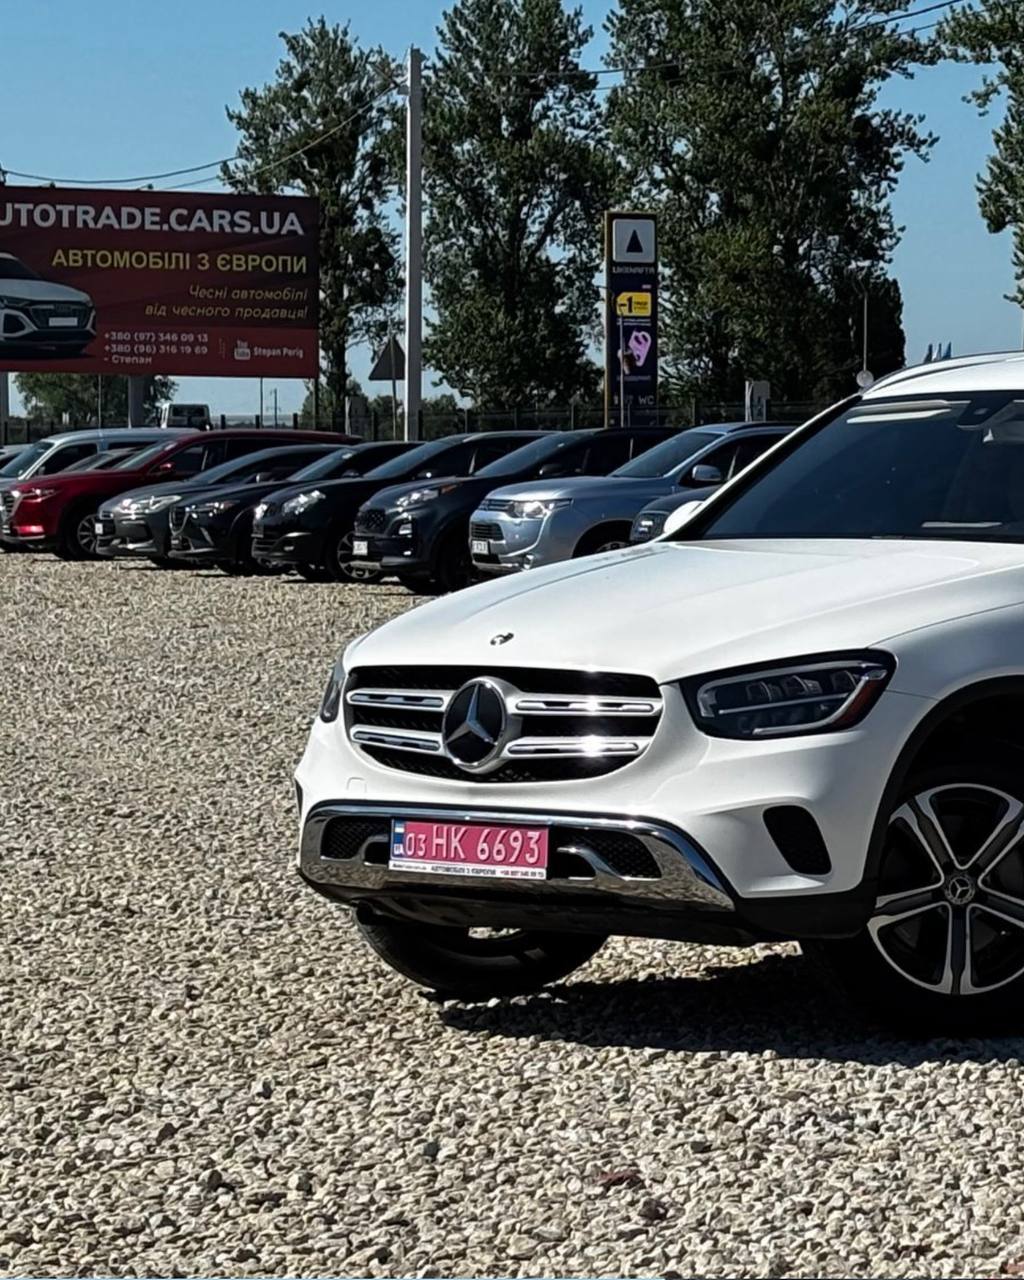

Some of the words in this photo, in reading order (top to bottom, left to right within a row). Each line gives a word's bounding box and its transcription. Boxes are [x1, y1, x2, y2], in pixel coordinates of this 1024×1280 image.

[52, 249, 190, 270] АВТОМОБІЛІ
[216, 254, 306, 273] ЄВРОПИ
[189, 285, 228, 299] Чесні
[145, 303, 167, 317] від
[172, 306, 231, 317] чесного
[111, 354, 153, 364] Степан
[405, 832, 426, 857] 03
[477, 828, 541, 864] 6693
